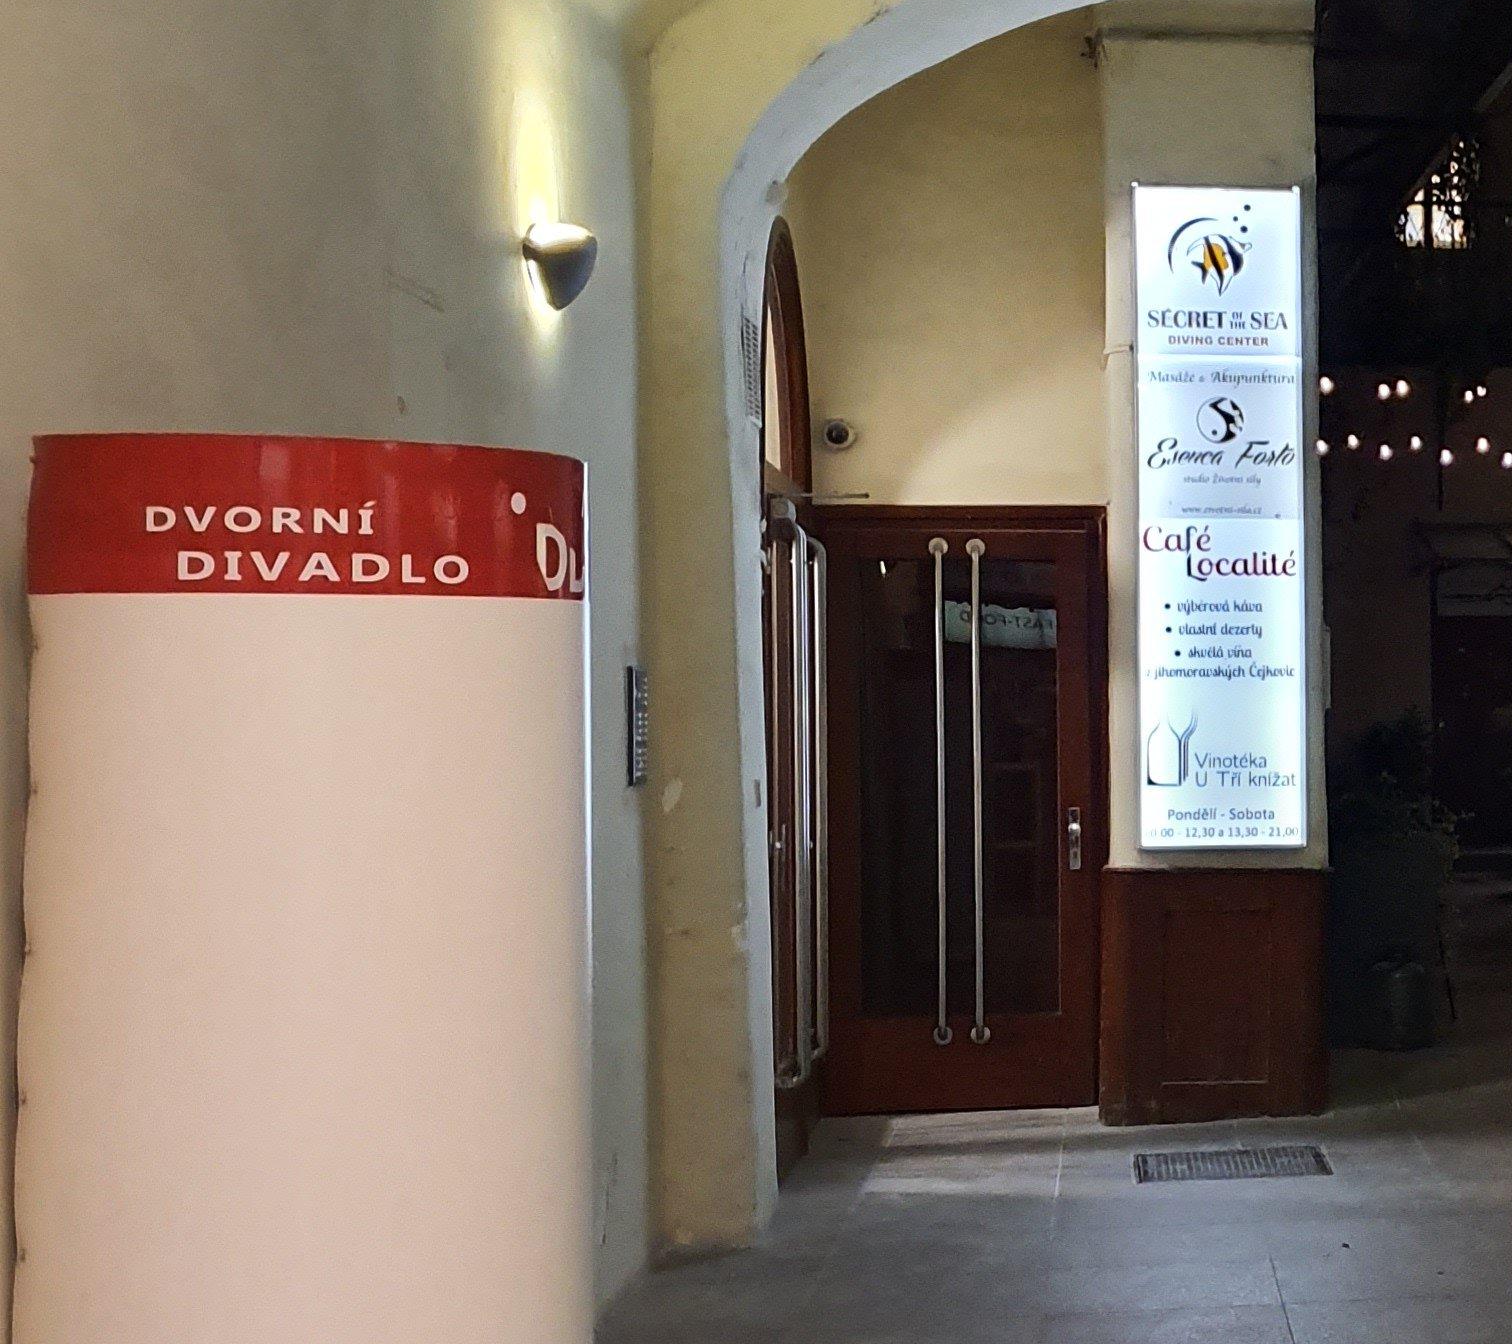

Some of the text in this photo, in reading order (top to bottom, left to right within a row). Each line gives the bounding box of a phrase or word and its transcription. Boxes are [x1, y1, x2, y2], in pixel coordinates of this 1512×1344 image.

[1250, 311, 1288, 330] SEA
[1168, 335, 1269, 347] DIVING CENTER
[1211, 369, 1295, 386] Akupunktura
[145, 500, 376, 535] DVORNÍ
[1143, 526, 1211, 553] Café
[177, 550, 470, 585] DIVADLO
[1187, 550, 1296, 581] Localité
[1177, 599, 1263, 615] výběrová káva
[1178, 623, 1263, 638] vlastní dezerty
[1188, 645, 1252, 658] skvělá vína
[1155, 665, 1245, 681] jihomoravských
[1194, 753, 1267, 769] Vinotéka
[1195, 771, 1296, 787] U Tří knížat
[1168, 808, 1216, 821] Pondělí
[1229, 808, 1275, 821] Sobota
[1185, 827, 1215, 839] 12,30
[1218, 830, 1224, 838] a
[1228, 827, 1258, 839] 13,30
